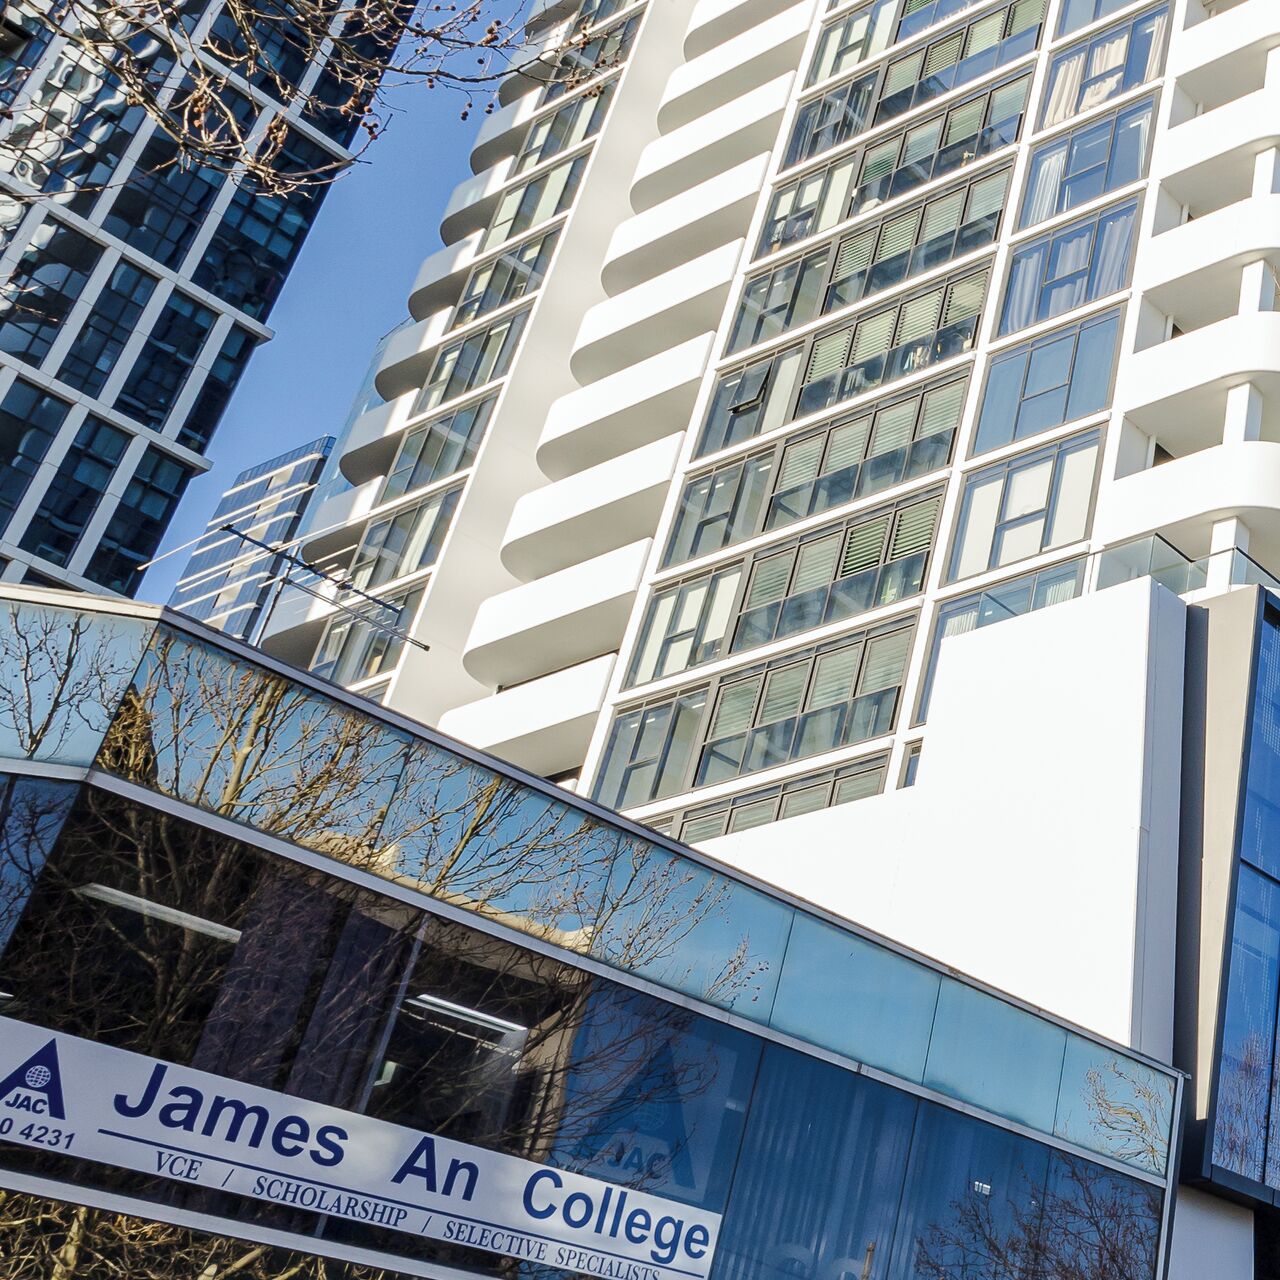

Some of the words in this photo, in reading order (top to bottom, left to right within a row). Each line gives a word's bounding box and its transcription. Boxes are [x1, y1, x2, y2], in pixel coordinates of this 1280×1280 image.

[5, 1093, 48, 1115] JAC
[19, 1123, 76, 1150] 4231
[114, 1063, 349, 1167] James
[391, 1136, 479, 1202] An
[523, 1169, 710, 1265] College
[155, 1151, 203, 1181] VCE
[252, 1175, 408, 1227] SCHOLARSHIP
[443, 1220, 549, 1261] SELECTIVE
